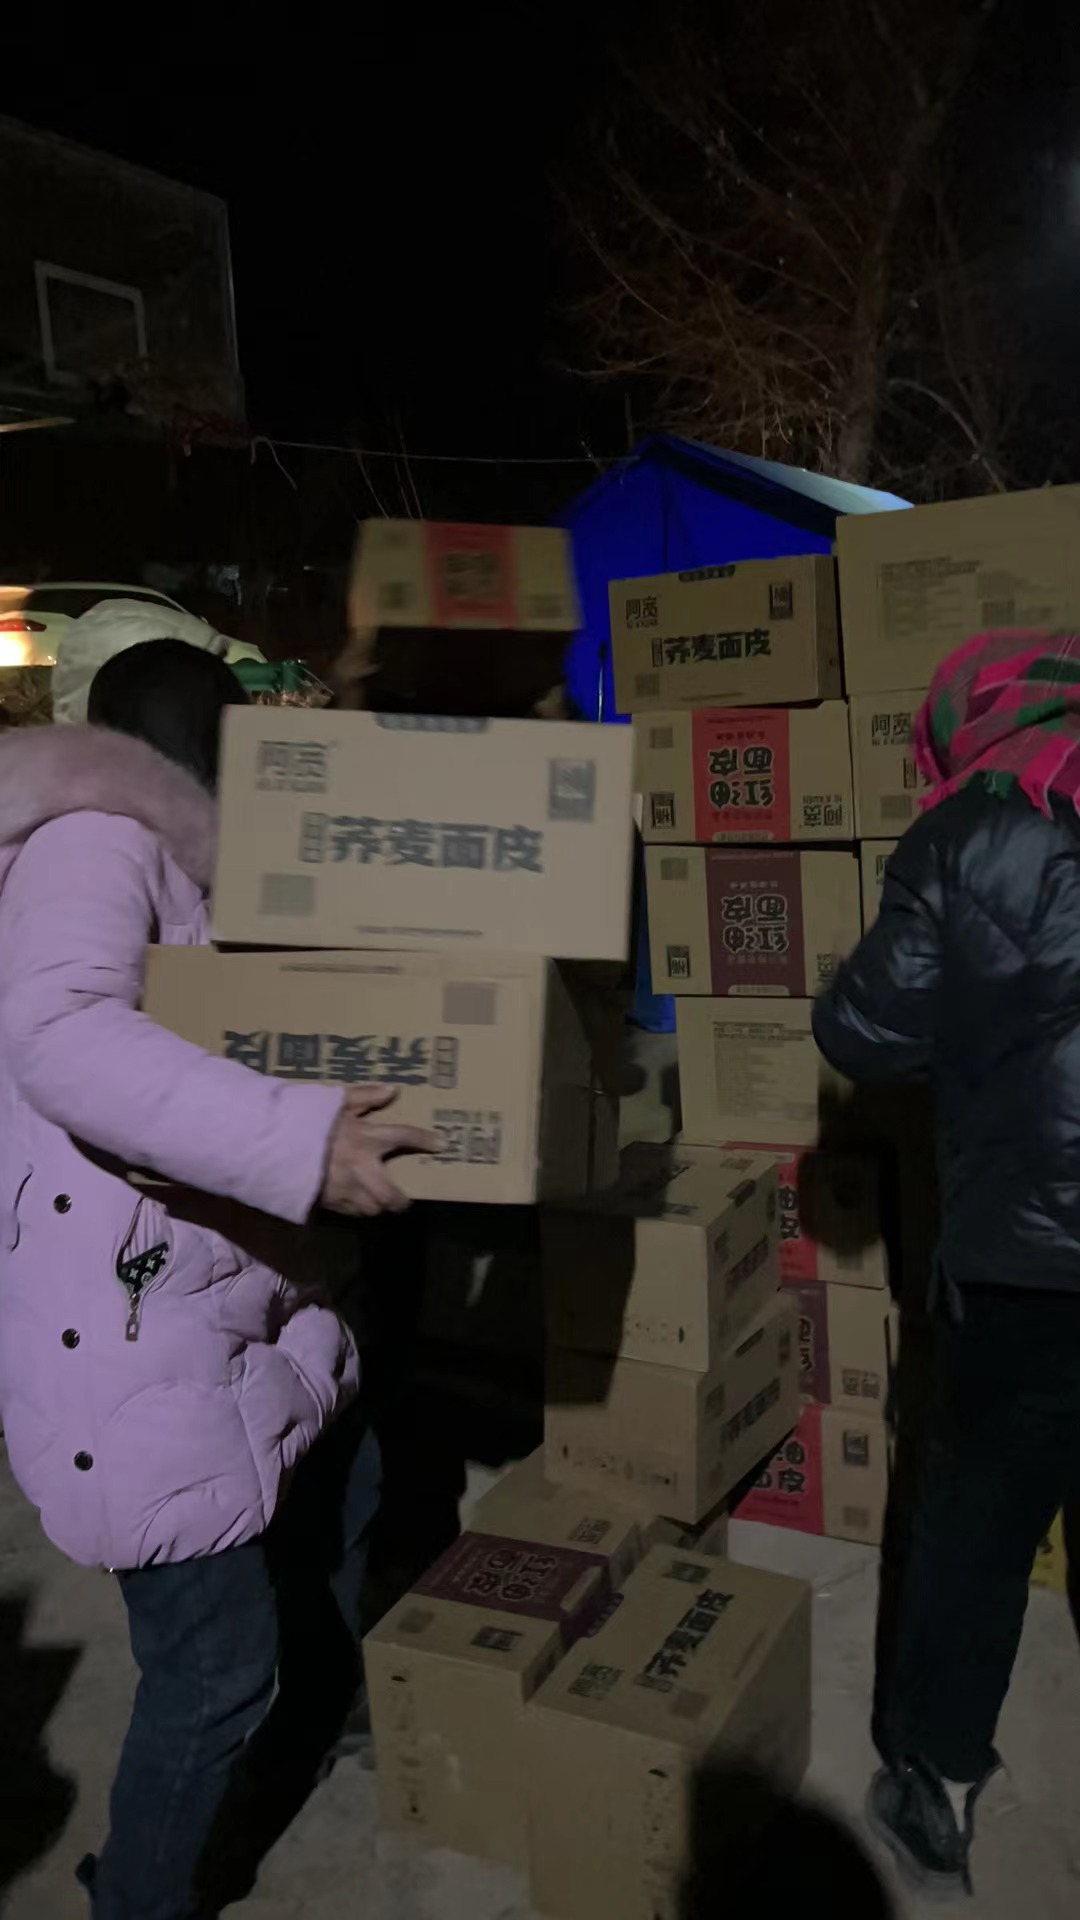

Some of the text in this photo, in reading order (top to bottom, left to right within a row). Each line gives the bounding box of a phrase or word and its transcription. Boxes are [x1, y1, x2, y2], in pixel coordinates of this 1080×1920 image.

[664, 628, 771, 664] 荞麦面皮
[708, 746, 774, 776] 面皮
[708, 778, 774, 809] 红油
[802, 804, 843, 827] 阿宽
[330, 815, 544, 873] 荞麦面皮
[721, 894, 788, 924] 面皮
[722, 923, 789, 954] 红油
